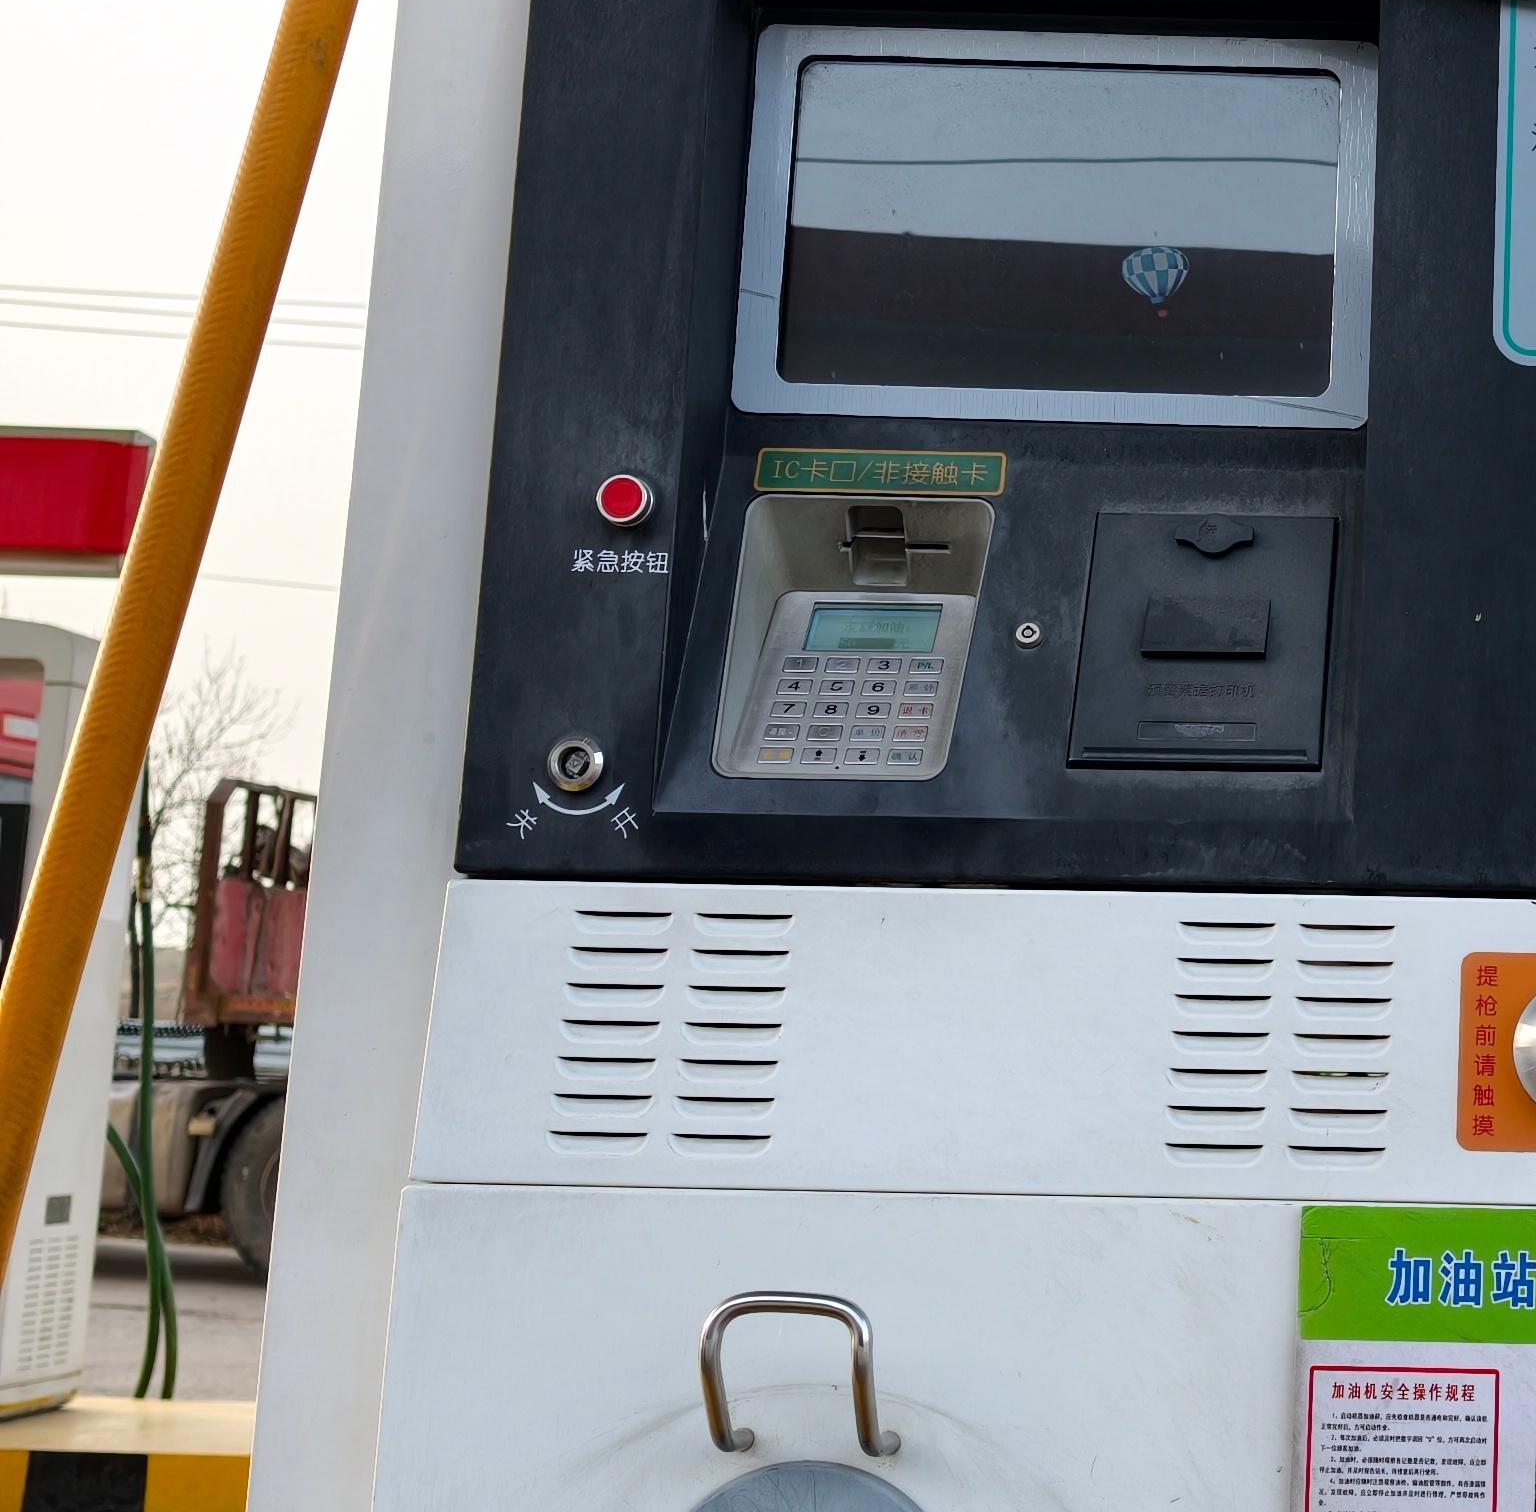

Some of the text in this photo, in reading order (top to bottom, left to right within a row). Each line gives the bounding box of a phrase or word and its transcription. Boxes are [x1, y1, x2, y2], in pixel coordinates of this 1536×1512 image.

[570, 548, 670, 575] 紧急按钮
[877, 660, 890, 671] 3
[787, 681, 801, 691] 4
[871, 682, 885, 692] 6
[782, 703, 796, 714] 7
[824, 704, 838, 715] 8
[866, 704, 880, 715] 9
[505, 807, 538, 840] 关
[610, 807, 640, 840] 开
[1471, 965, 1499, 1137] 提枪前请触摸
[1331, 1381, 1476, 1403] 加油机安全操作规程
